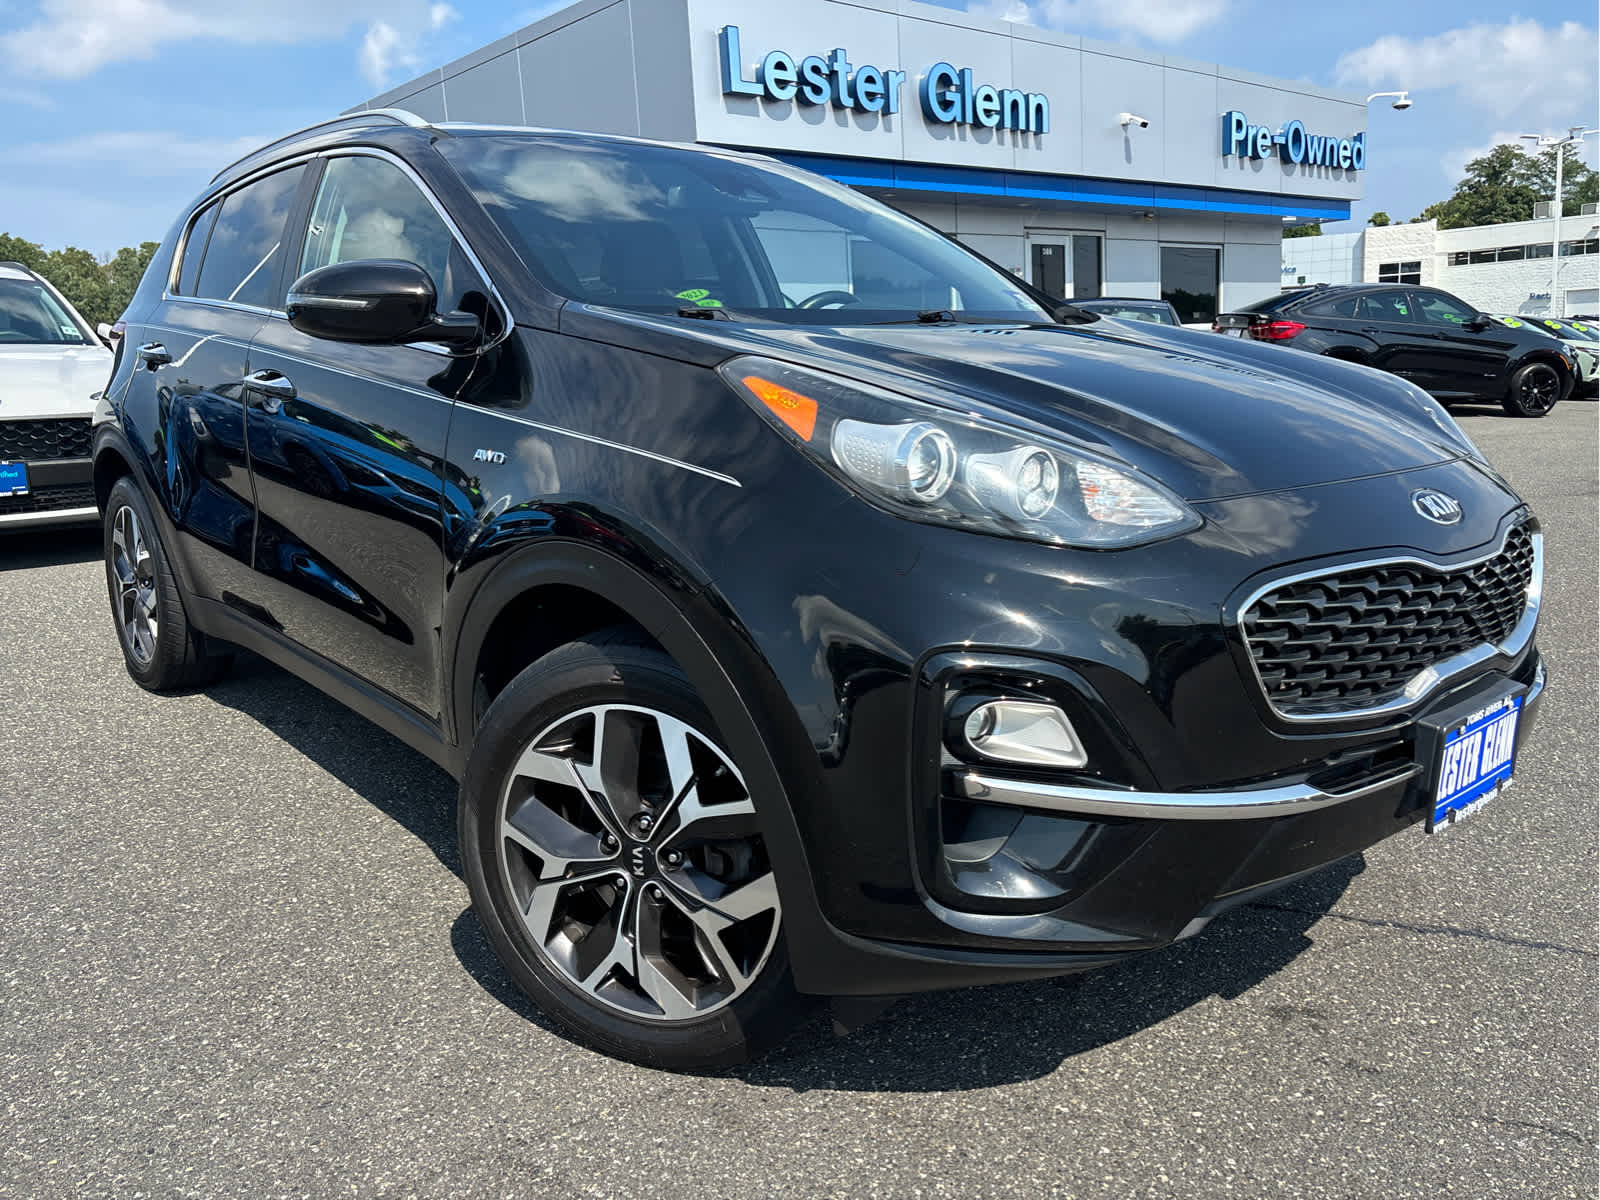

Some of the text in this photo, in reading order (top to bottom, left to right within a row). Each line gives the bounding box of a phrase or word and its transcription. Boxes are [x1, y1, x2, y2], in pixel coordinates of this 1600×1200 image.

[718, 24, 1050, 135] Lester Glenn
[1222, 110, 1366, 171] Pre-Owned
[472, 448, 507, 464] AWD
[1418, 493, 1460, 518] KIA
[1436, 711, 1519, 802] LESTER GLENN
[632, 846, 645, 876] KIA
